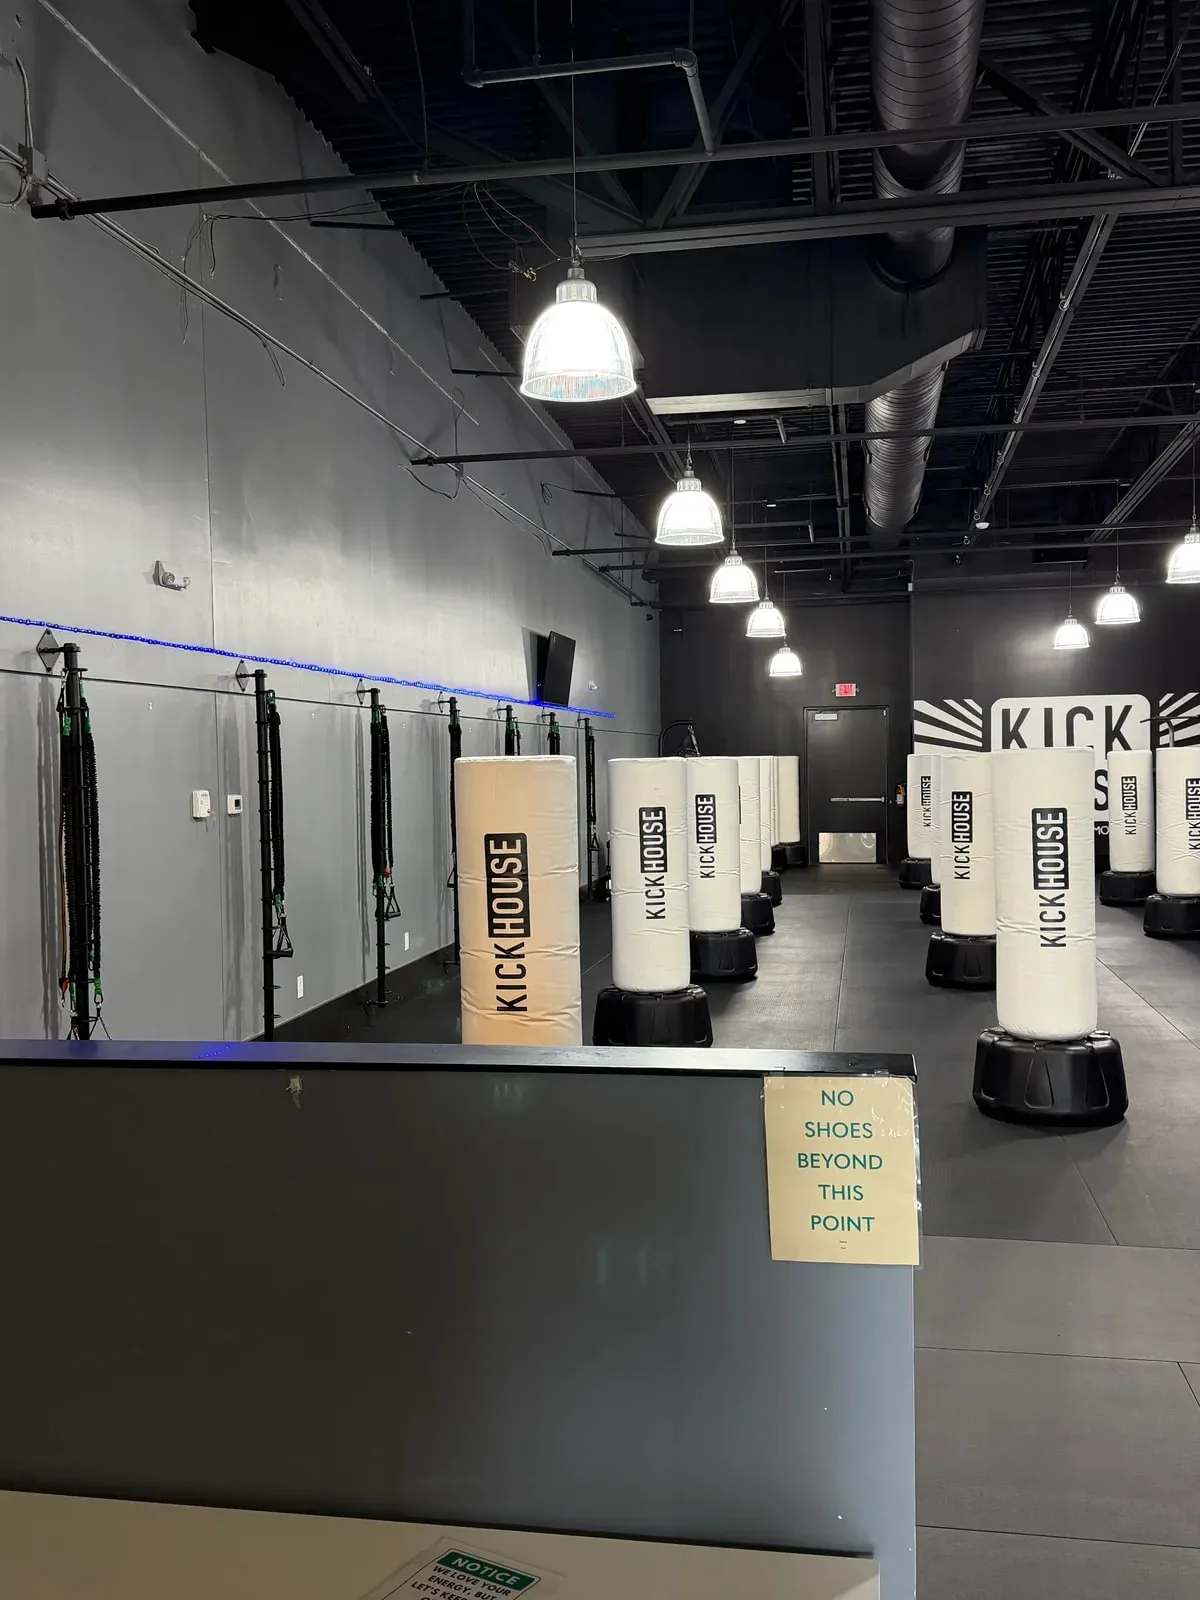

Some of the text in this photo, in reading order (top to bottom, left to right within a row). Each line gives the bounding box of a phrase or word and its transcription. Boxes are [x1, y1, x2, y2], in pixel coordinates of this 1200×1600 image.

[821, 1090, 854, 1107] NO
[804, 1121, 873, 1139] SHOES
[797, 1153, 883, 1170] BEYOND
[818, 1184, 864, 1201] THIS
[810, 1215, 875, 1232] POINT
[451, 1557, 521, 1585] NOTICE
[411, 1581, 440, 1595] LET'S
[433, 1565, 511, 1597] WE LOVE YOUR
[474, 1591, 498, 1600] BUT
